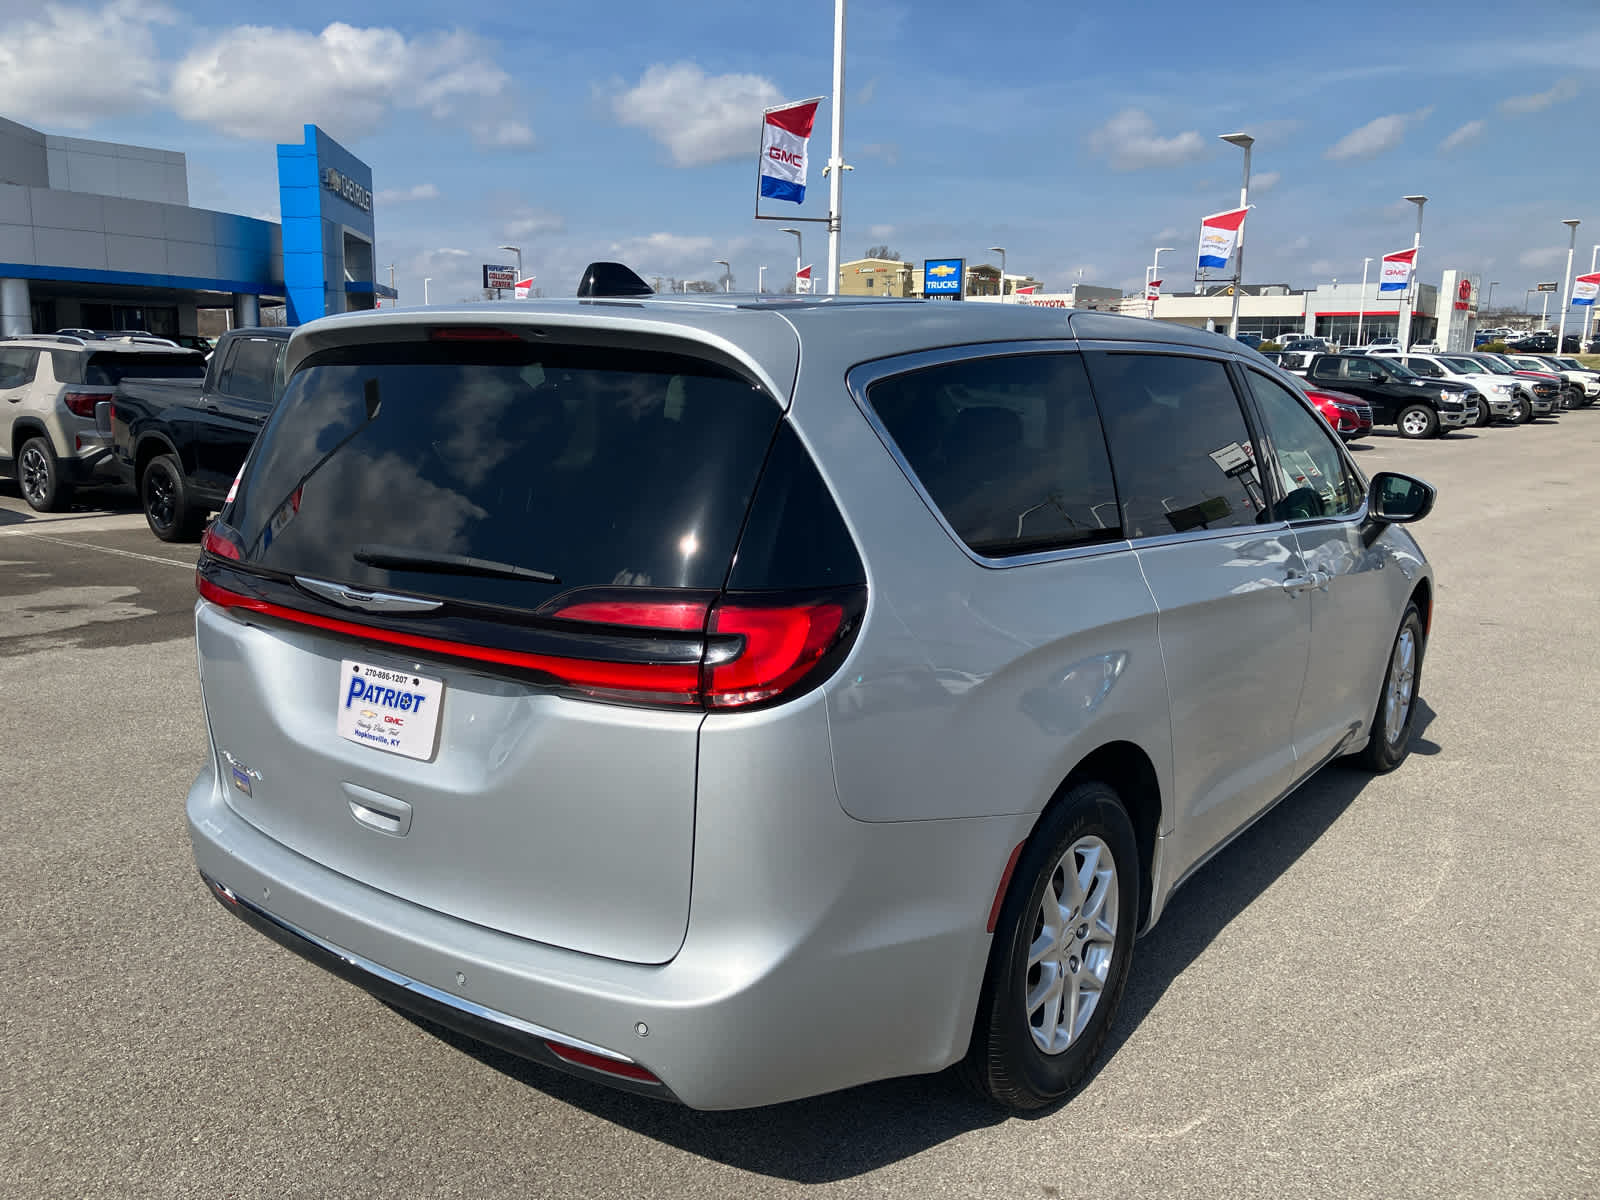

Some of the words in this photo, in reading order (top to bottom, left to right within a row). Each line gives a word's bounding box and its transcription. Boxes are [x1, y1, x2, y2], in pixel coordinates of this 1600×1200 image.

[769, 146, 802, 168] GMC
[341, 174, 371, 209] CHEVROLET
[491, 280, 511, 288] CENTER
[926, 280, 958, 289] TRUCKS
[365, 668, 408, 683] 270-886-1207
[345, 675, 426, 713] PATRIOT
[384, 715, 404, 726] GMC
[390, 738, 401, 747] KY
